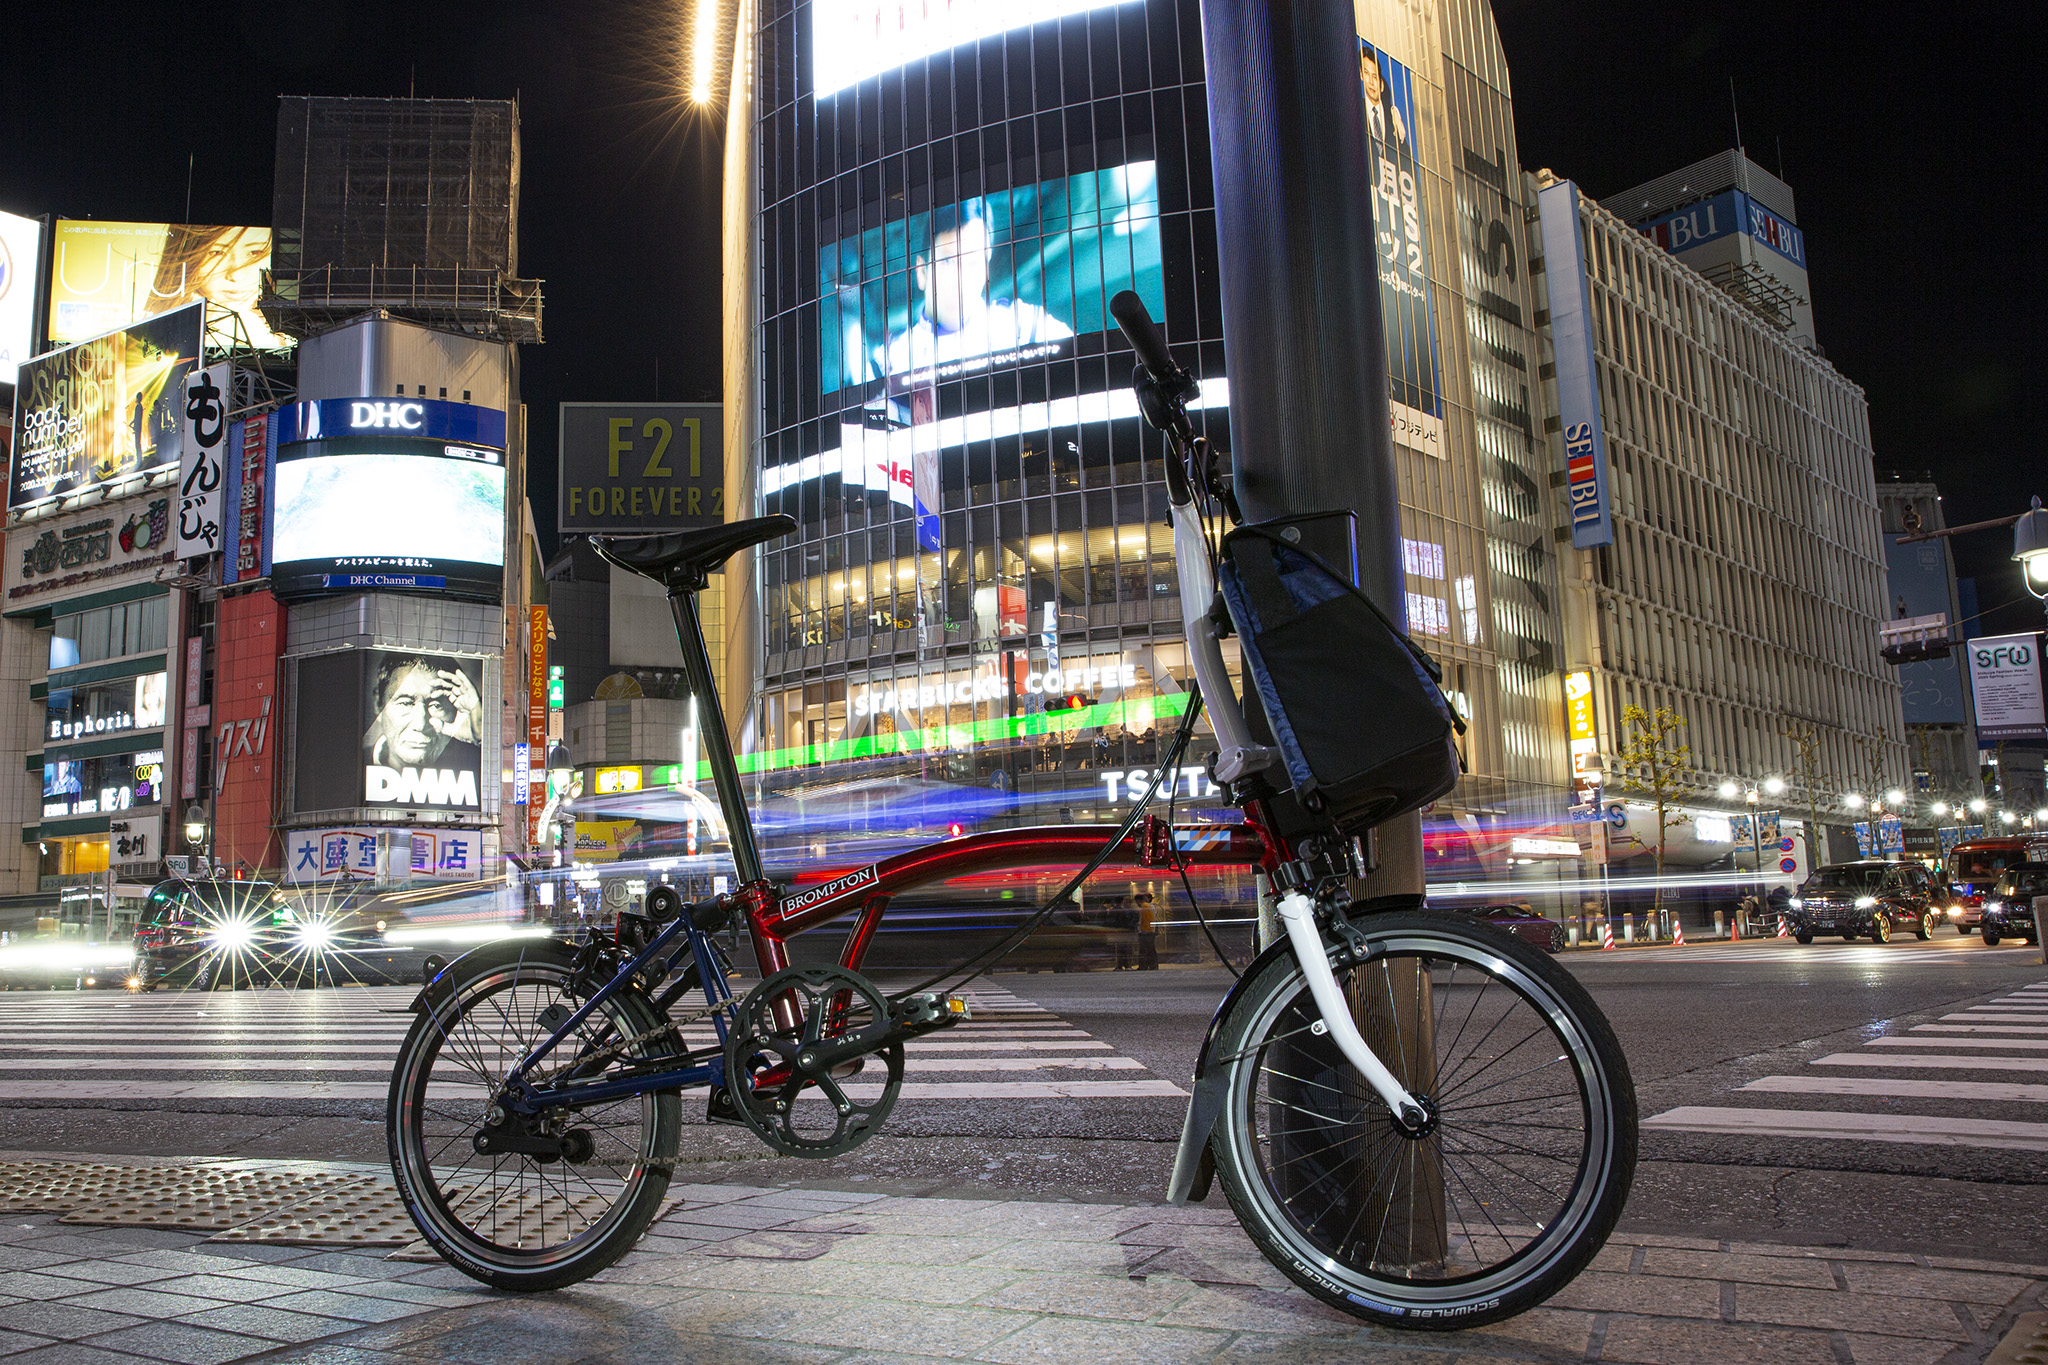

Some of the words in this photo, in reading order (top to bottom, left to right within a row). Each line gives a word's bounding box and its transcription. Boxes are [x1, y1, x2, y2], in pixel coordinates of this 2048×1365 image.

[1750, 204, 1801, 262] SEIBU
[60, 241, 187, 298] Uru
[23, 412, 85, 447] number
[24, 400, 61, 430] back
[351, 402, 423, 430] DHC
[179, 372, 224, 549] もんじゃ
[609, 417, 701, 477] F21
[236, 420, 261, 571] 三千里薬品
[1565, 421, 1600, 531] SEIBU
[570, 487, 701, 516] FOREVER
[350, 575, 374, 585] DHC
[375, 575, 416, 586] Channel
[533, 610, 544, 698] クスリのことなら
[1976, 645, 2032, 669] SFW
[854, 675, 1009, 717] STARBUCKS
[1024, 663, 1137, 696] COFFEE
[51, 711, 131, 740] Euphoria
[530, 706, 545, 762] 三千里
[365, 765, 478, 806] DMM
[786, 868, 870, 912] BROMPTON
[438, 1241, 495, 1278] SCHWALBE
[1292, 1260, 1344, 1296] RACER
[1409, 1298, 1501, 1319] SCHWALBE
